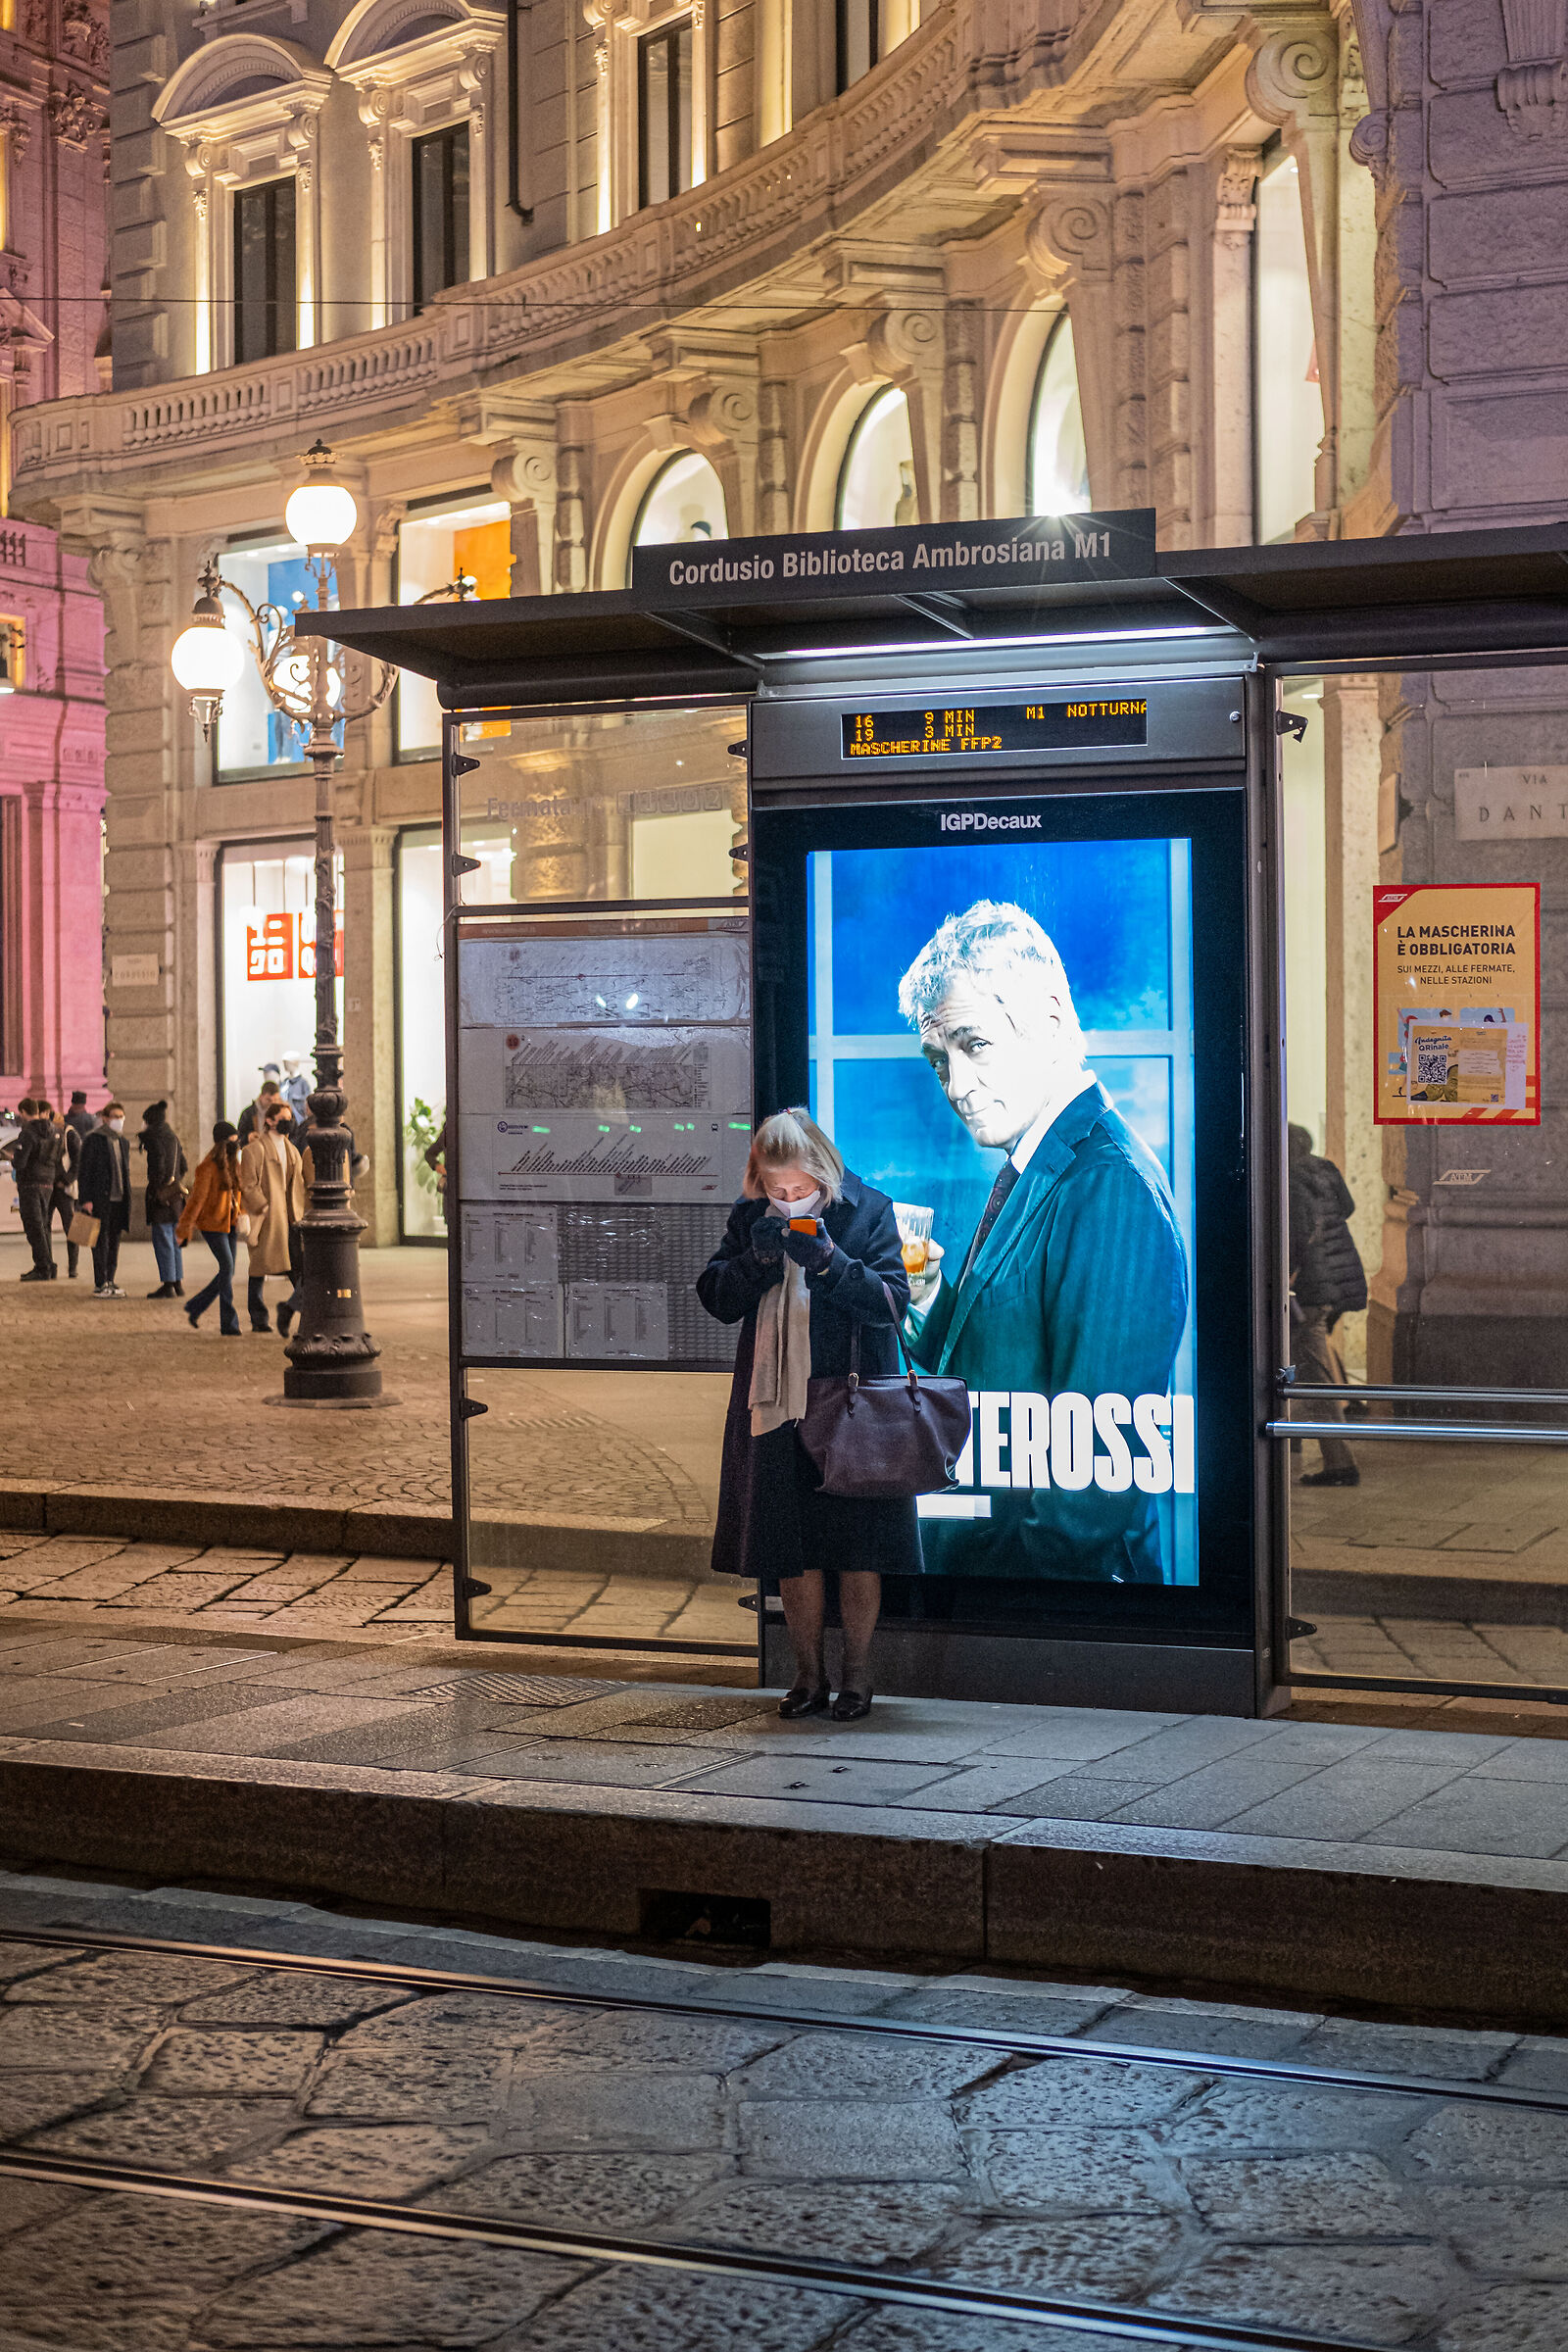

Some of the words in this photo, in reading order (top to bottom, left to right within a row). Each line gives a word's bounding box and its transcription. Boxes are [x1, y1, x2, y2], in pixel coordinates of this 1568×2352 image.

[669, 555, 774, 586] Cordusio
[783, 549, 905, 578] Biblioteca
[911, 537, 1065, 569] Ambrosiana
[1075, 532, 1110, 559] M1
[856, 714, 874, 728] 16
[924, 711, 934, 725] 9
[944, 710, 975, 723] MIN
[1026, 706, 1045, 719] M1
[856, 728, 874, 742] 19
[924, 725, 934, 738] 3
[944, 723, 975, 737] MIN
[850, 738, 952, 756] MASCHERINE
[960, 736, 1002, 751] FFP2
[1522, 774, 1547, 784] VIA
[487, 795, 570, 821] Fermata
[941, 813, 1042, 831] IGPDecaux
[1397, 926, 1415, 938] LA
[1419, 925, 1516, 938] MASCHERINA
[1397, 940, 1406, 956] È
[1409, 943, 1516, 956] OBBLIGATORIA
[1414, 964, 1444, 974] MEZZI,
[1446, 964, 1468, 973] ALLE
[1471, 963, 1516, 973] FERMATE,
[1420, 976, 1449, 985] NELLE
